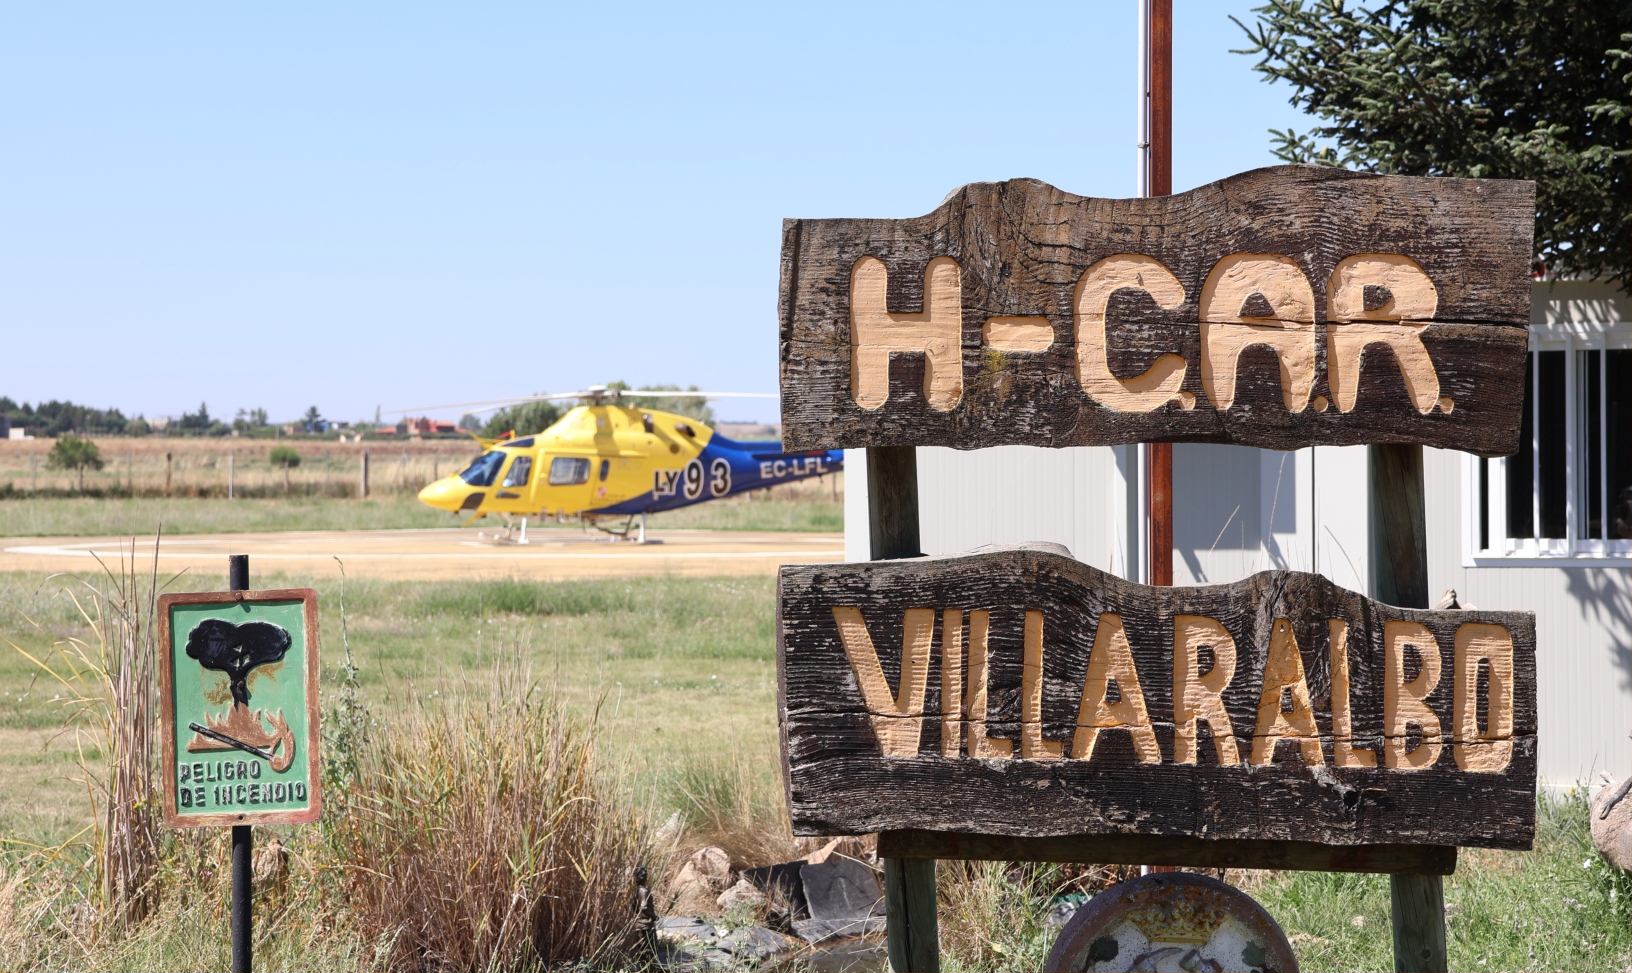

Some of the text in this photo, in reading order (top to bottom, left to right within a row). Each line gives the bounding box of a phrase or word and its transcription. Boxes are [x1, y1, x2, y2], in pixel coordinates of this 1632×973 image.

[760, 457, 828, 480] EC-LFL
[831, 606, 1514, 772] VILLARALBO
[179, 759, 262, 783] PELIGRO
[180, 781, 307, 806] DE INCENDIO
